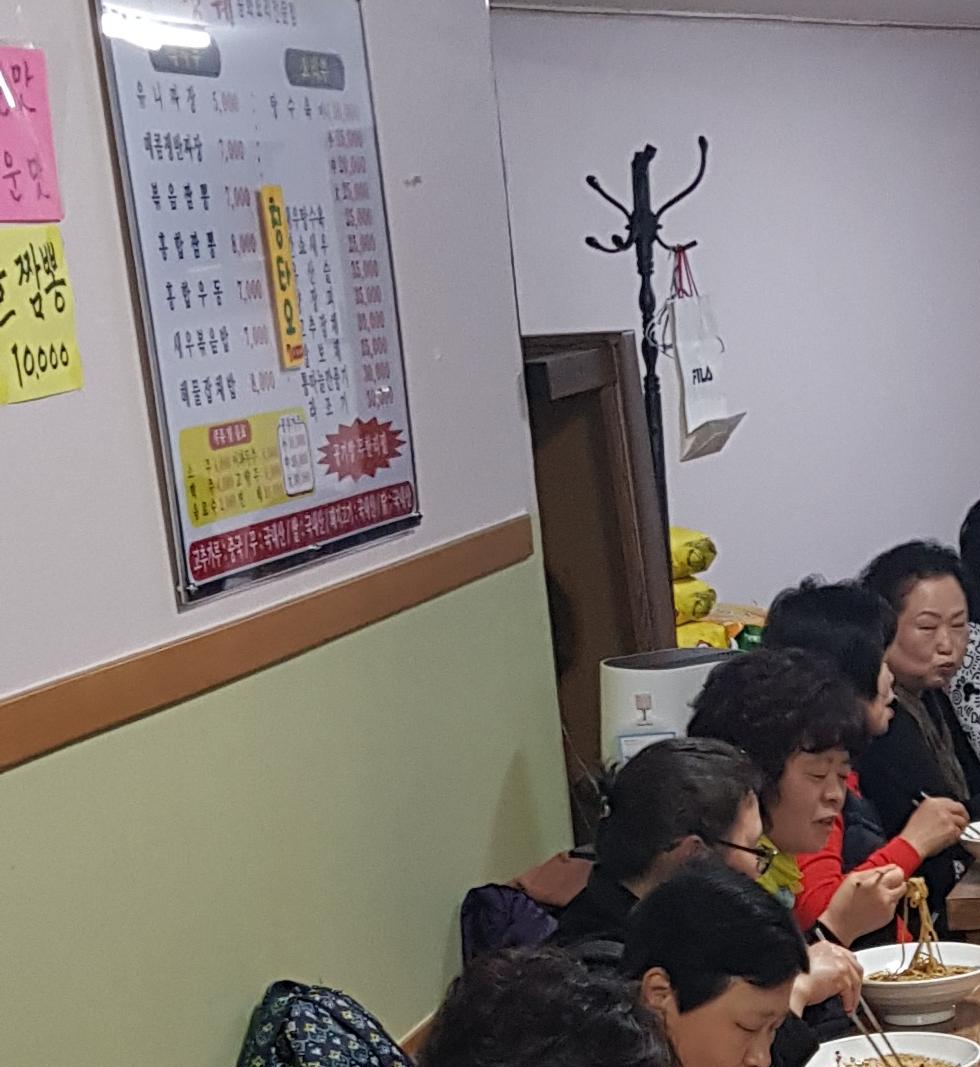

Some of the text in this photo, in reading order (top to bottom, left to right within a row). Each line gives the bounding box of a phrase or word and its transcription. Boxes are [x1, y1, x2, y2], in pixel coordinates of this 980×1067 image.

[218, 138, 245, 162] 7,000
[151, 182, 251, 211] 볶음짬뽕 7,000
[158, 231, 217, 261] 홍합짬뽕
[166, 279, 263, 311] 홍합우동 7,000
[173, 325, 229, 359] 새우볶음밥
[11, 343, 70, 388] 10,000
[692, 365, 713, 385] FILA
